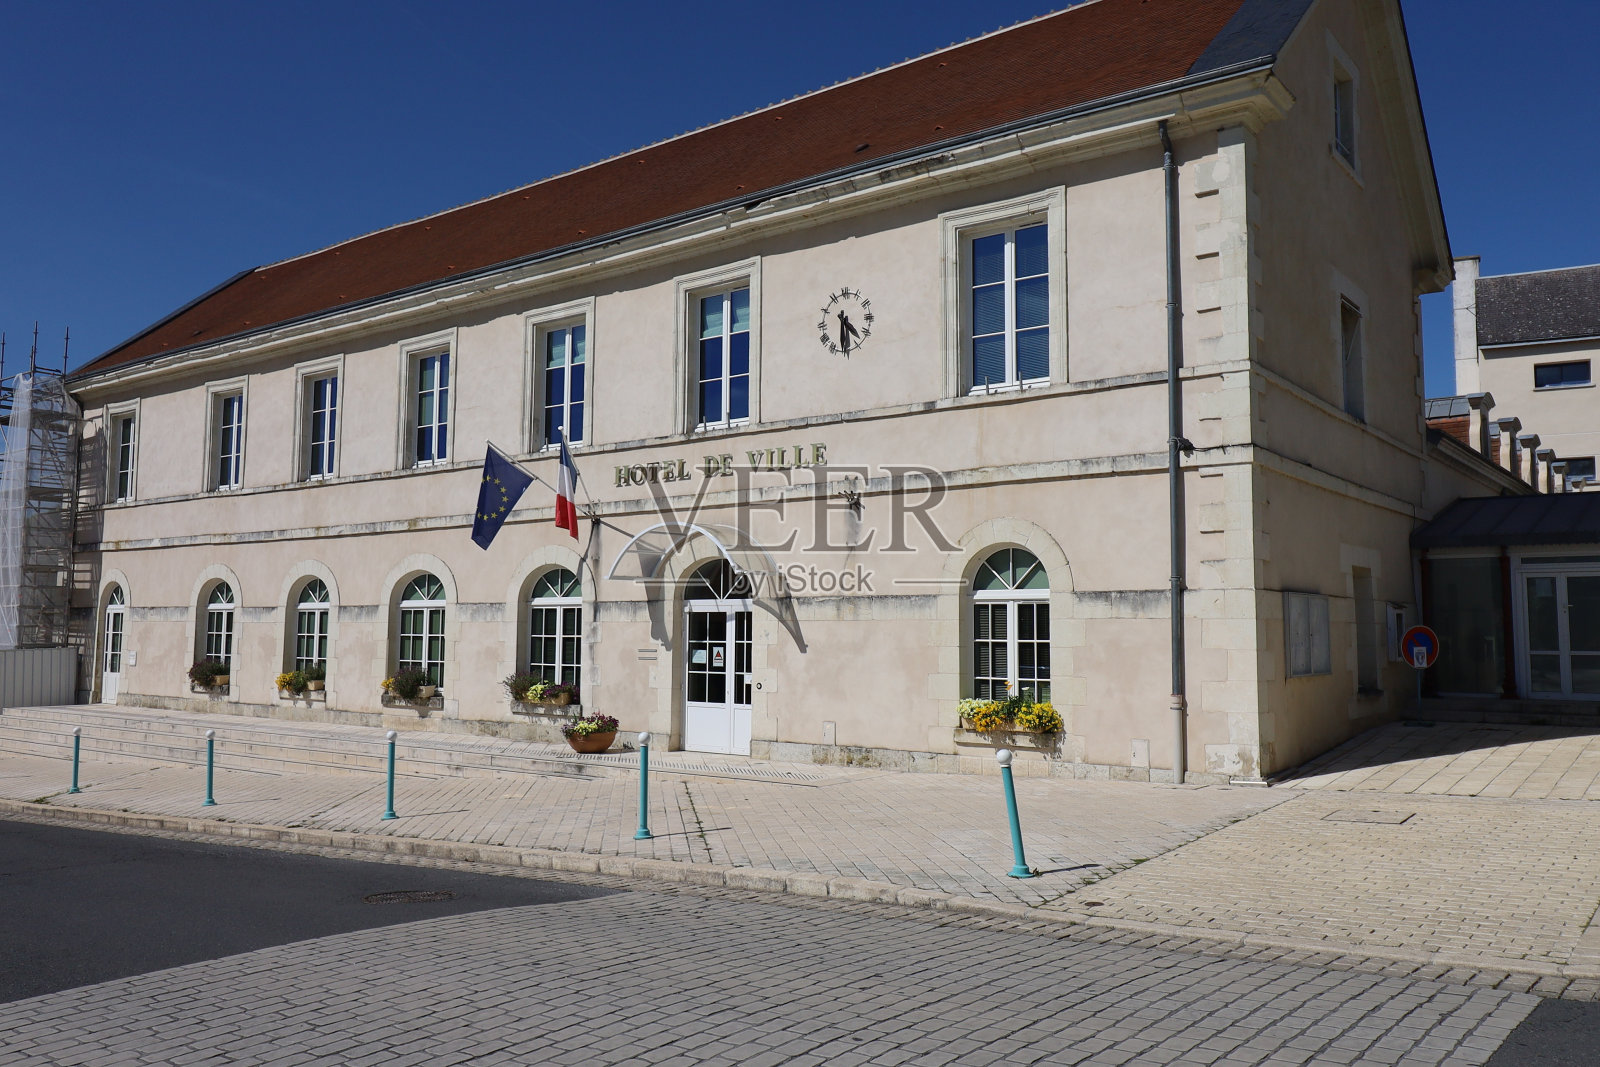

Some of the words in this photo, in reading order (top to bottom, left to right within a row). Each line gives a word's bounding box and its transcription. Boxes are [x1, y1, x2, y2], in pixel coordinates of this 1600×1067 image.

[613, 459, 691, 488] HOTEL
[702, 454, 734, 478] DE
[745, 442, 828, 473] VILLE
